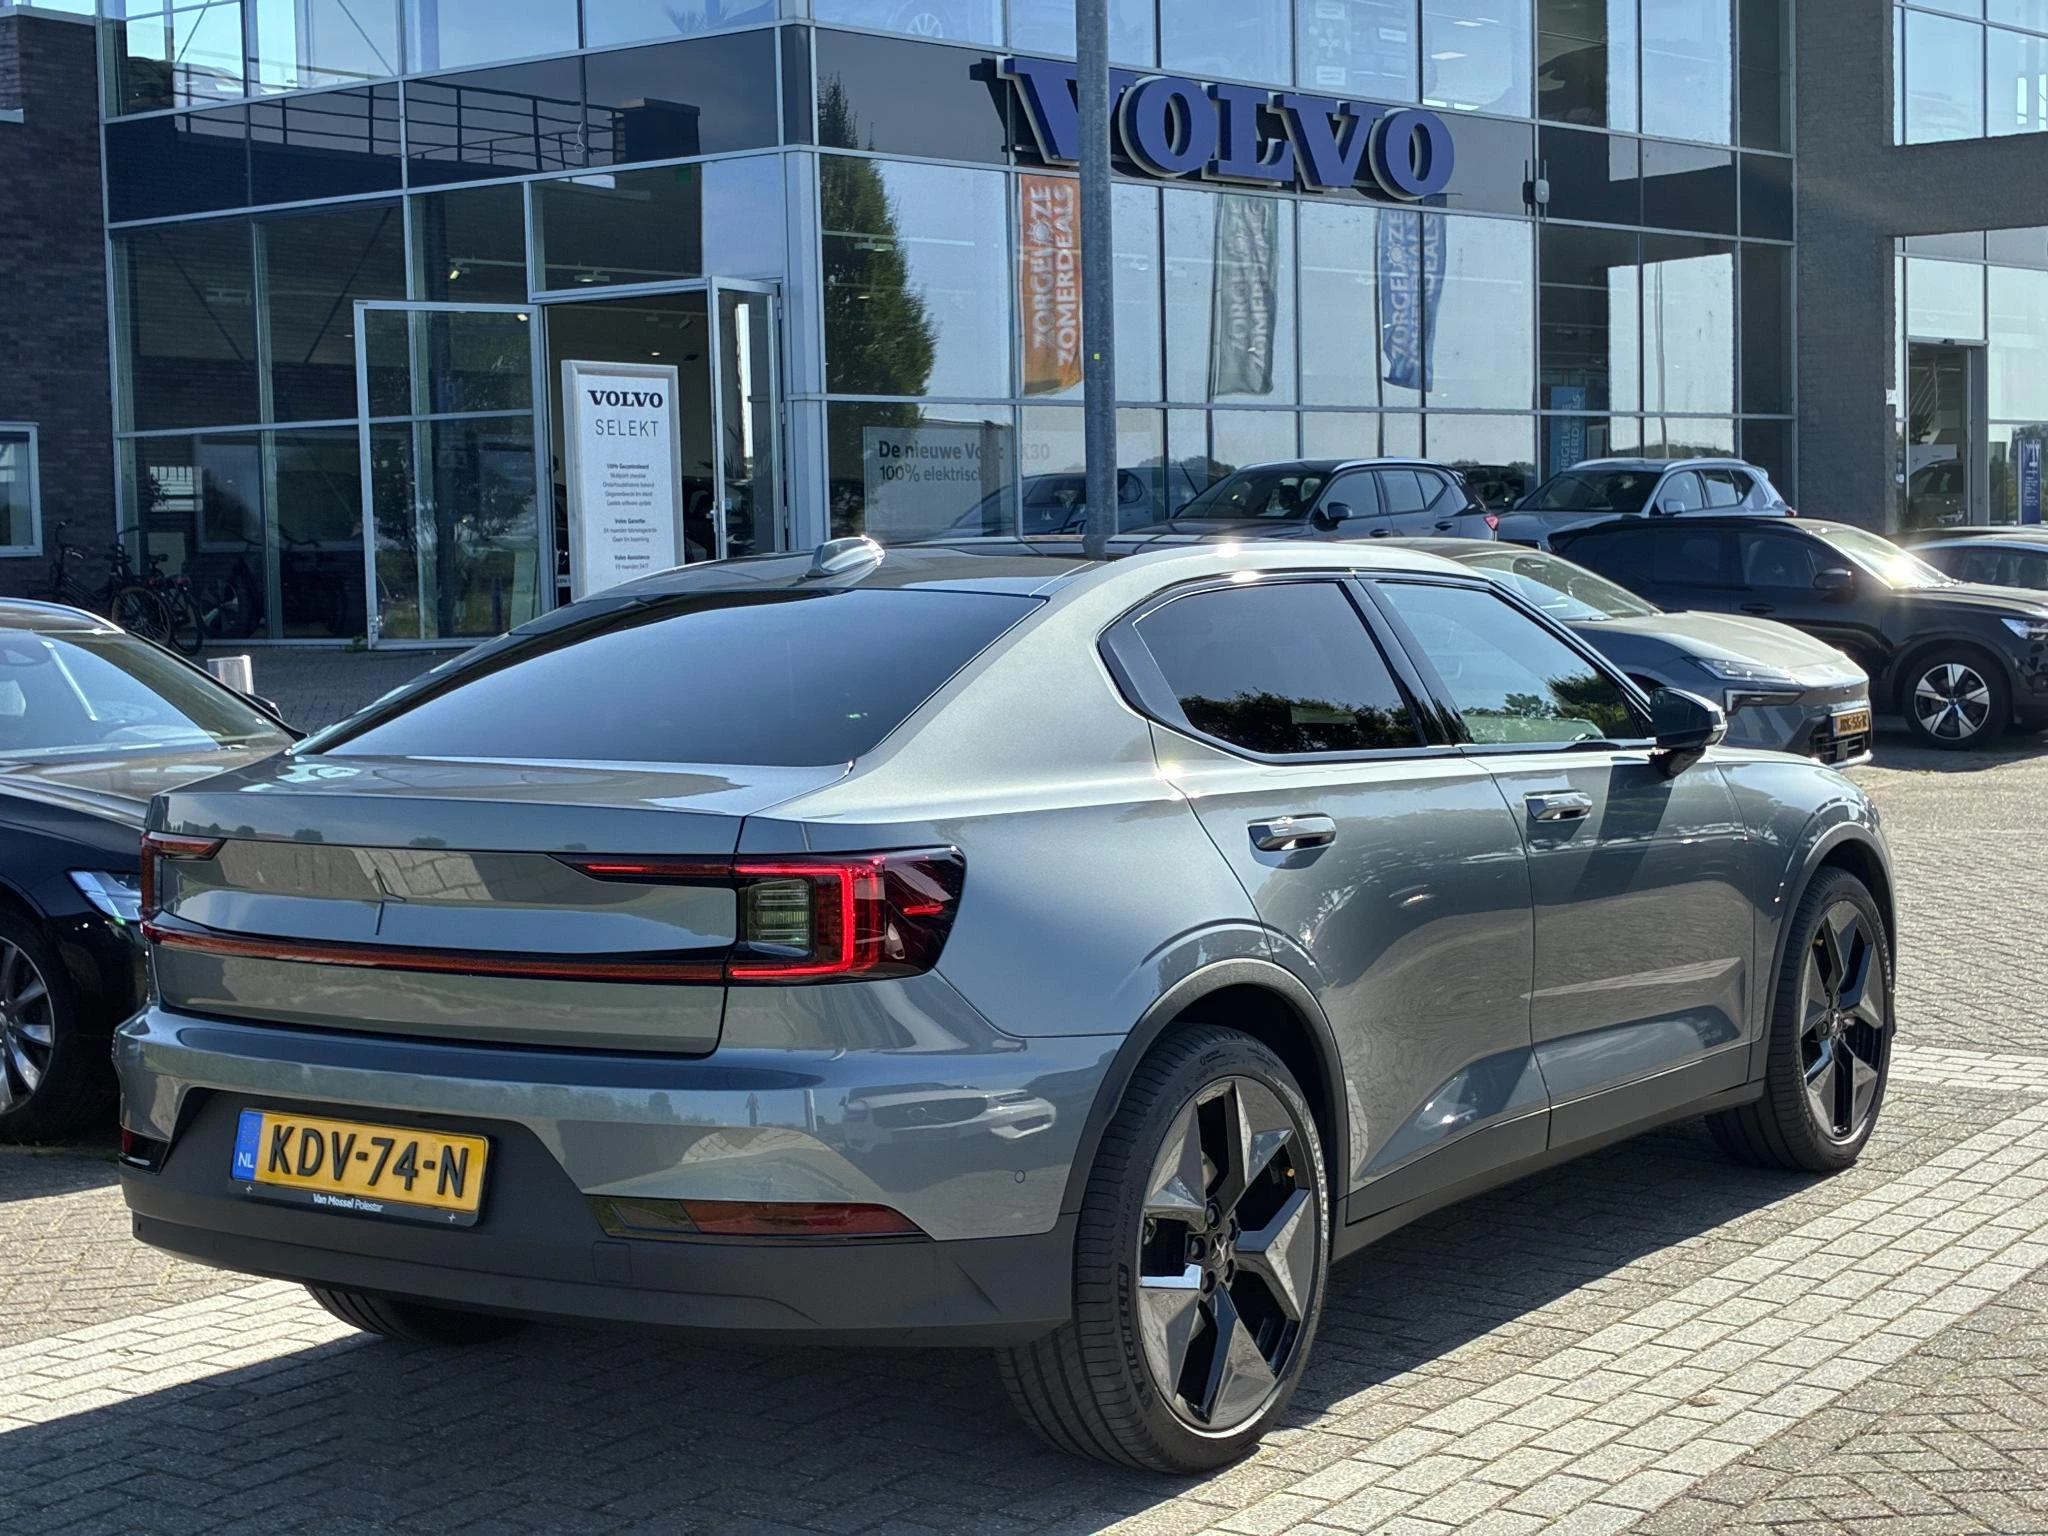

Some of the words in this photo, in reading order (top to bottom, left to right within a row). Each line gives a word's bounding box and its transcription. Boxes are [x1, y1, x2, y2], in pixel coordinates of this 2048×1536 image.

[998, 56, 1455, 198] VOLVO
[1054, 184, 1077, 367] ZOMERDEALS
[588, 390, 663, 408] VOLVO
[595, 418, 659, 437] SELEKT
[879, 440, 900, 458] De
[905, 441, 961, 459] nieuwe
[880, 463, 920, 482] 100%
[238, 1152, 254, 1169] NL
[268, 1124, 469, 1198] KDV-74-N
[312, 1193, 326, 1205] Van
[355, 1199, 383, 1212] Polestar
[1118, 1271, 1144, 1384] MICHELIN
